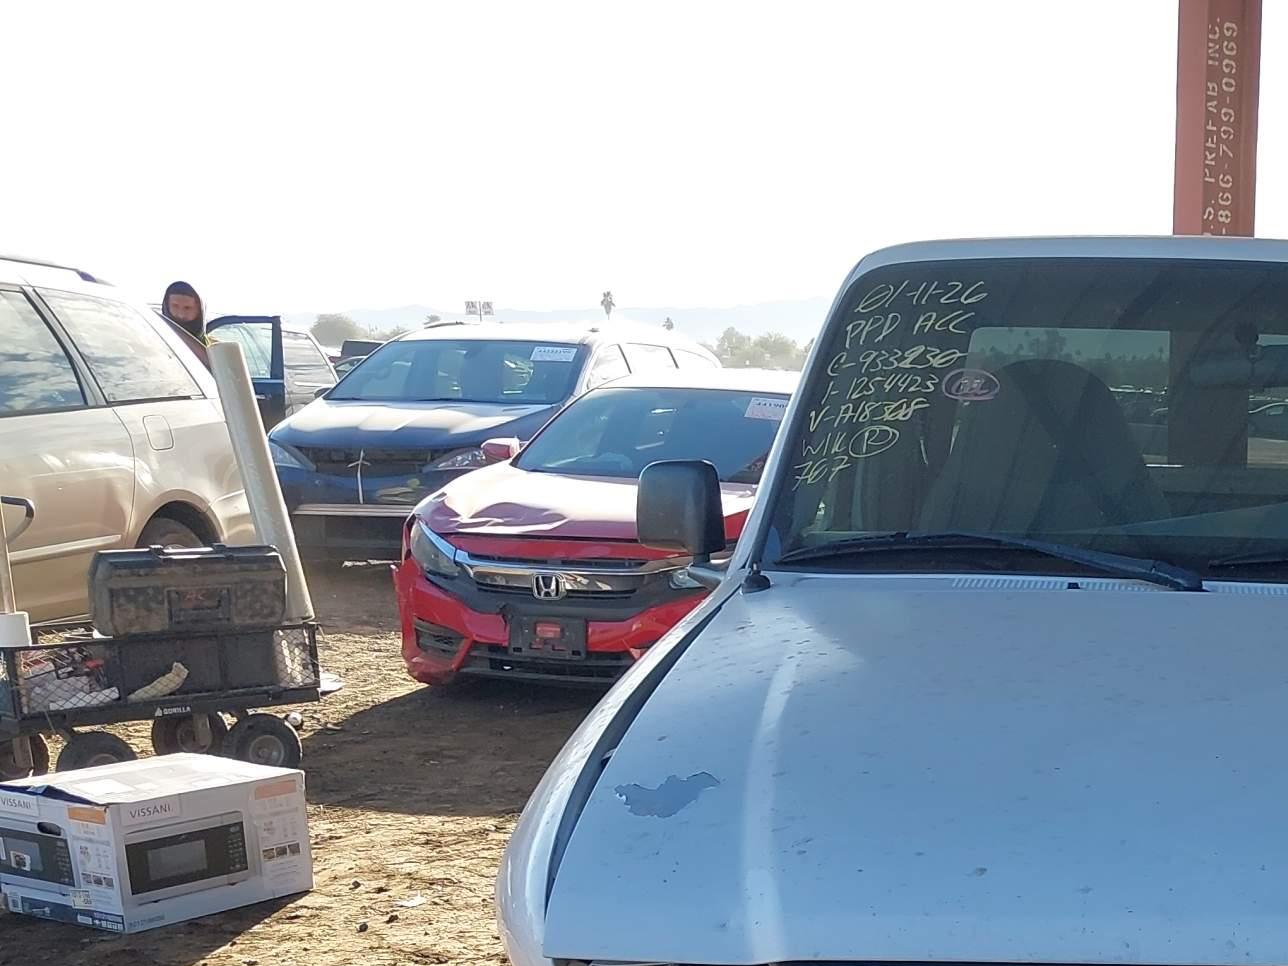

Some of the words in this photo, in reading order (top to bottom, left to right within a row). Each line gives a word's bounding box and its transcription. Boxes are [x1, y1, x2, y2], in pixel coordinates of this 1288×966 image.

[1207, 17, 1220, 66] INC.
[1204, 81, 1218, 183] PREFAB
[1203, 199, 1215, 235] .S.
[854, 280, 989, 313] 01-11-26
[846, 312, 901, 349] PPD
[912, 310, 976, 336] ACC
[1, 799, 32, 810] VISSANI
[129, 803, 173, 819] VISSANI
